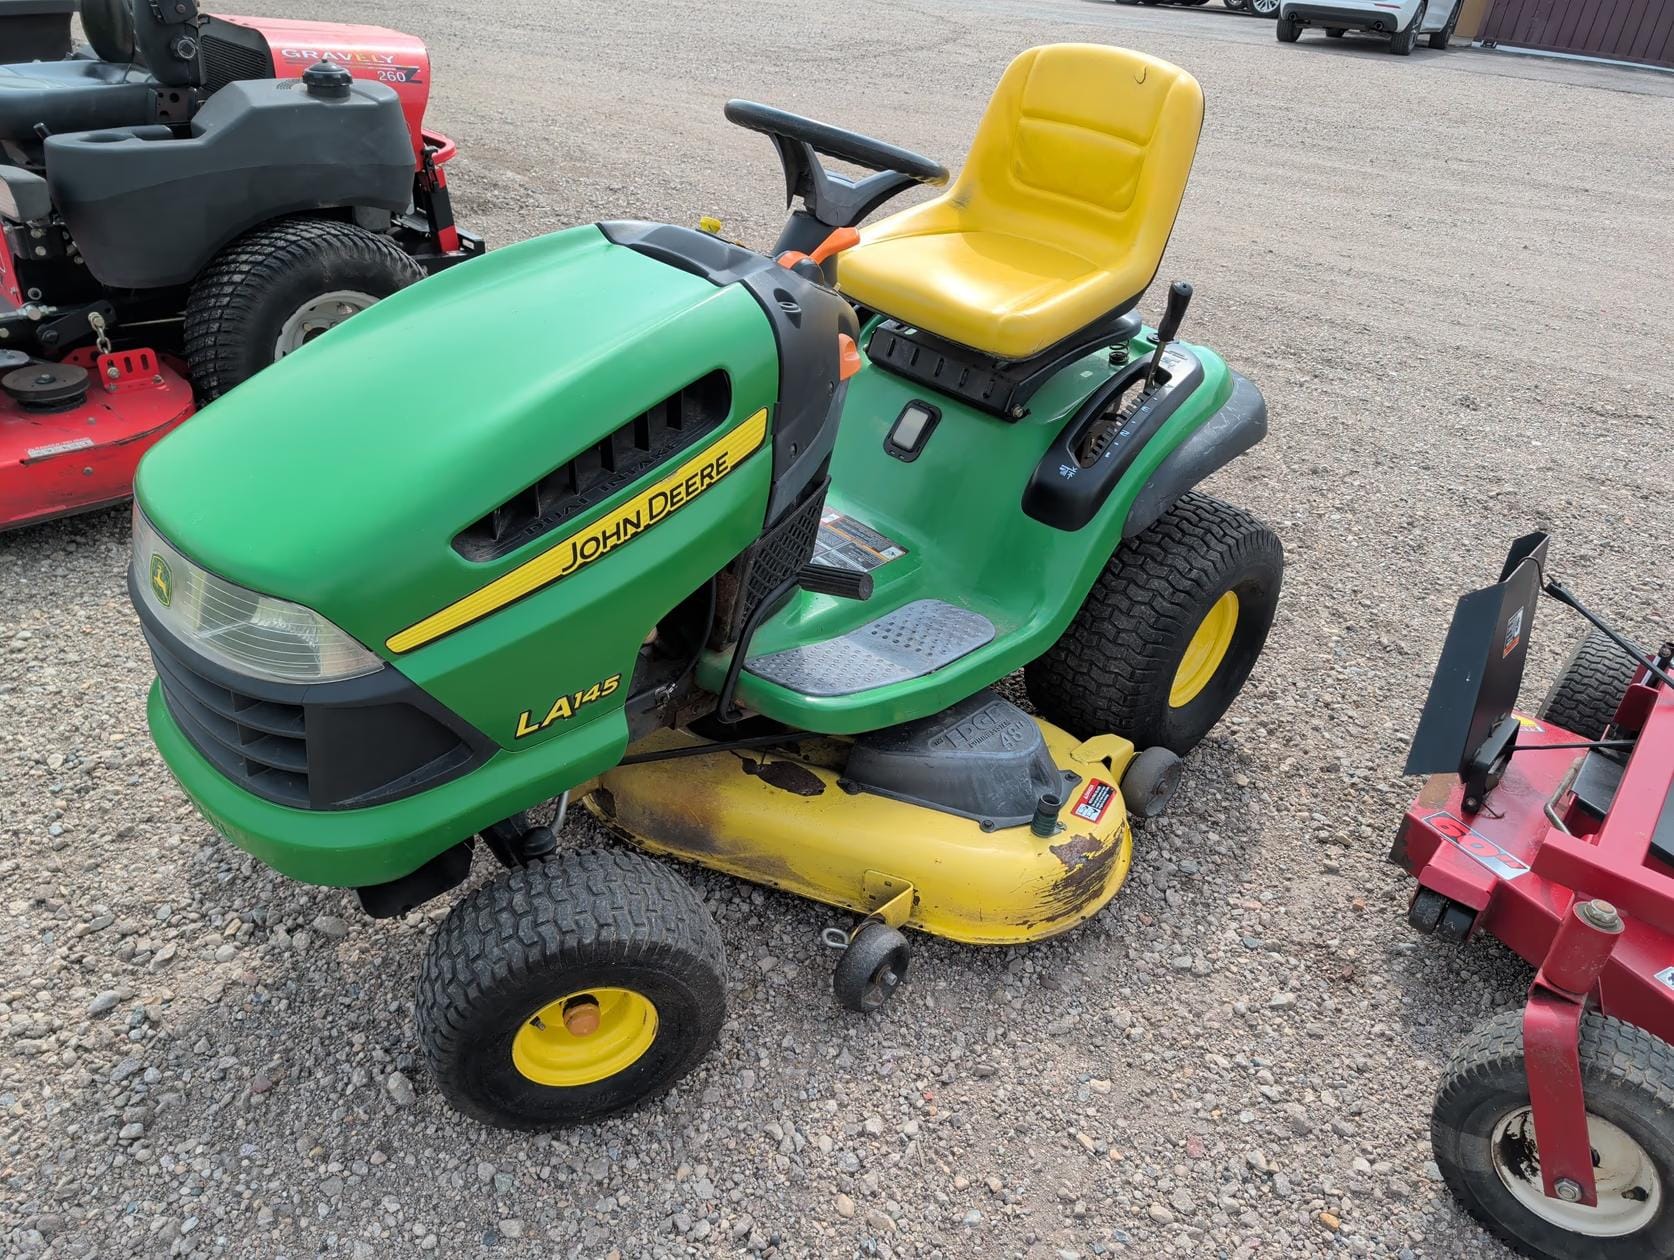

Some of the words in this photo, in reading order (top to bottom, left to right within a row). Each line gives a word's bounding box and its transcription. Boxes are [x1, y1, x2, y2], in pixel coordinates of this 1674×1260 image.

[282, 48, 394, 63] GRAVELY
[525, 498, 590, 535] DUAL
[561, 509, 641, 573] JOHN
[647, 451, 730, 519] DEERE
[515, 673, 621, 738] LA145
